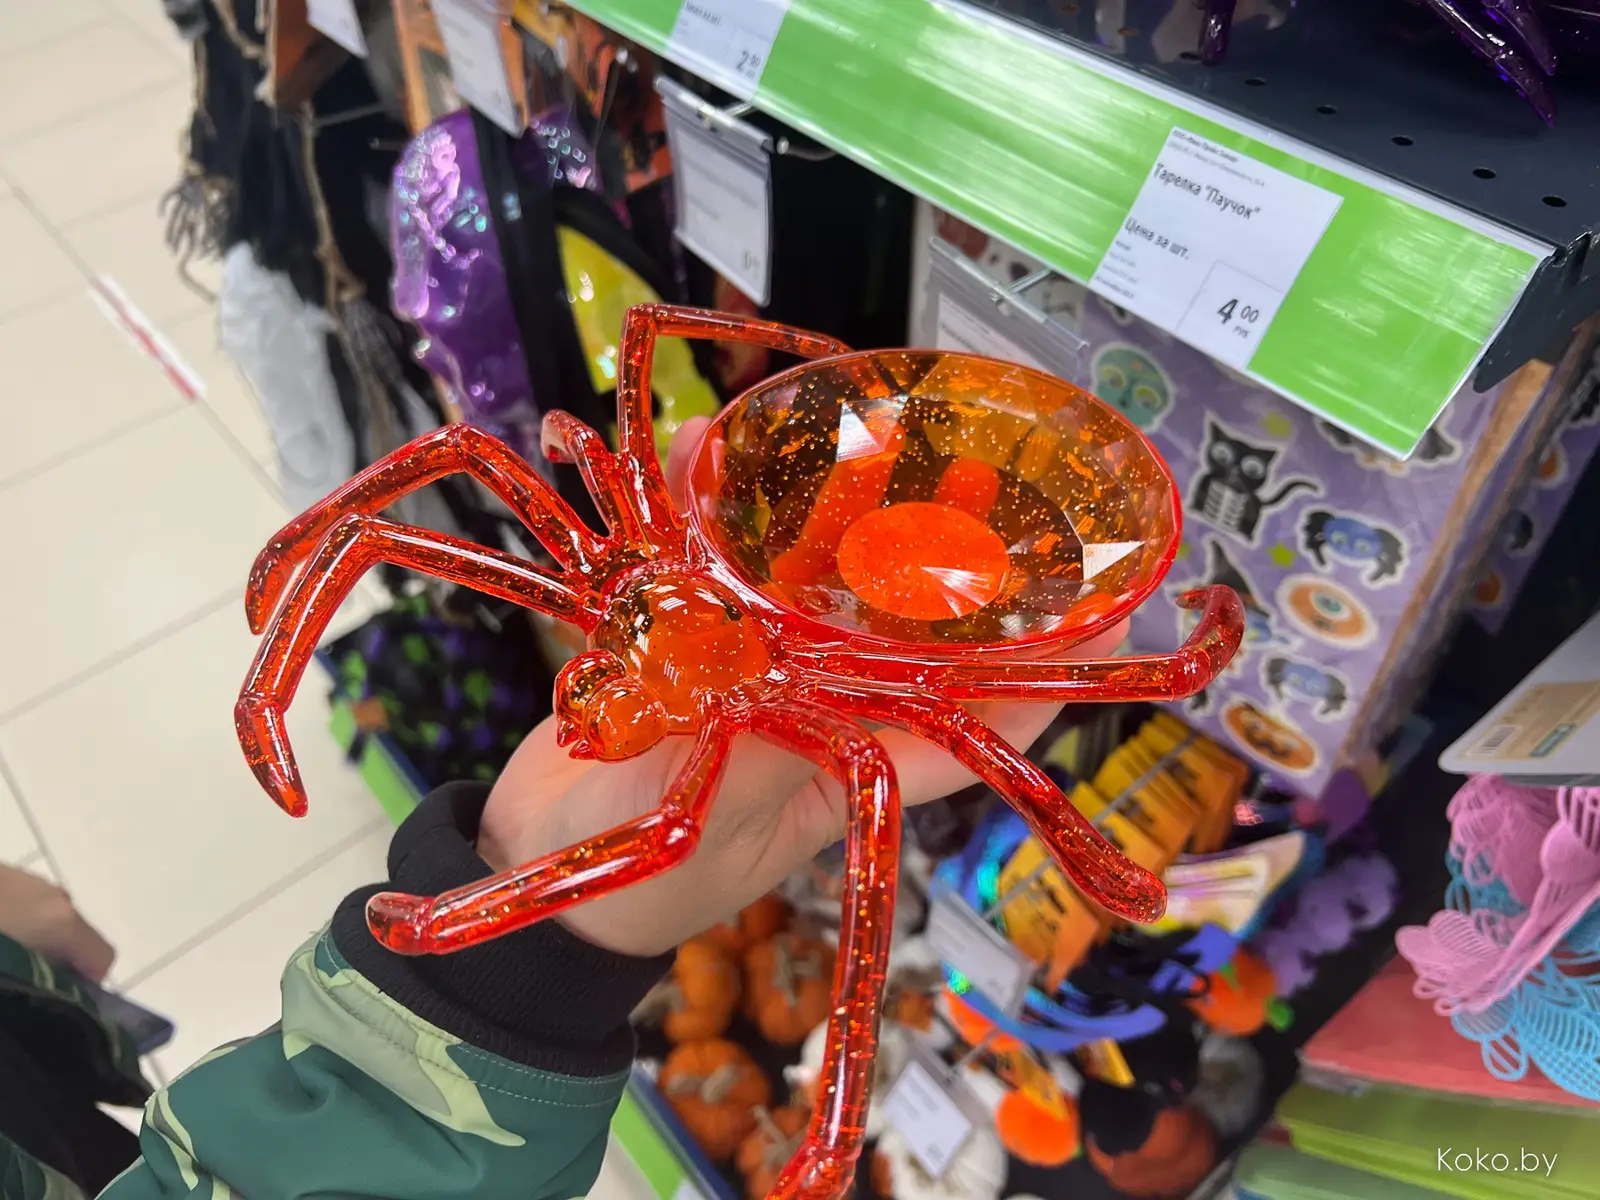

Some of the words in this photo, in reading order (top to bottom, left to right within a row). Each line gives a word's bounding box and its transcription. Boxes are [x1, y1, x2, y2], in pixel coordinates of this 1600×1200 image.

[735, 49, 749, 73] 2
[1153, 163, 1202, 196] Тарелка
[1205, 185, 1261, 220] "Паучок"
[1124, 217, 1154, 242] Цена
[1155, 235, 1169, 249] за
[1169, 243, 1189, 260] шт.
[1217, 298, 1238, 325] 4
[1240, 305, 1260, 324] 00
